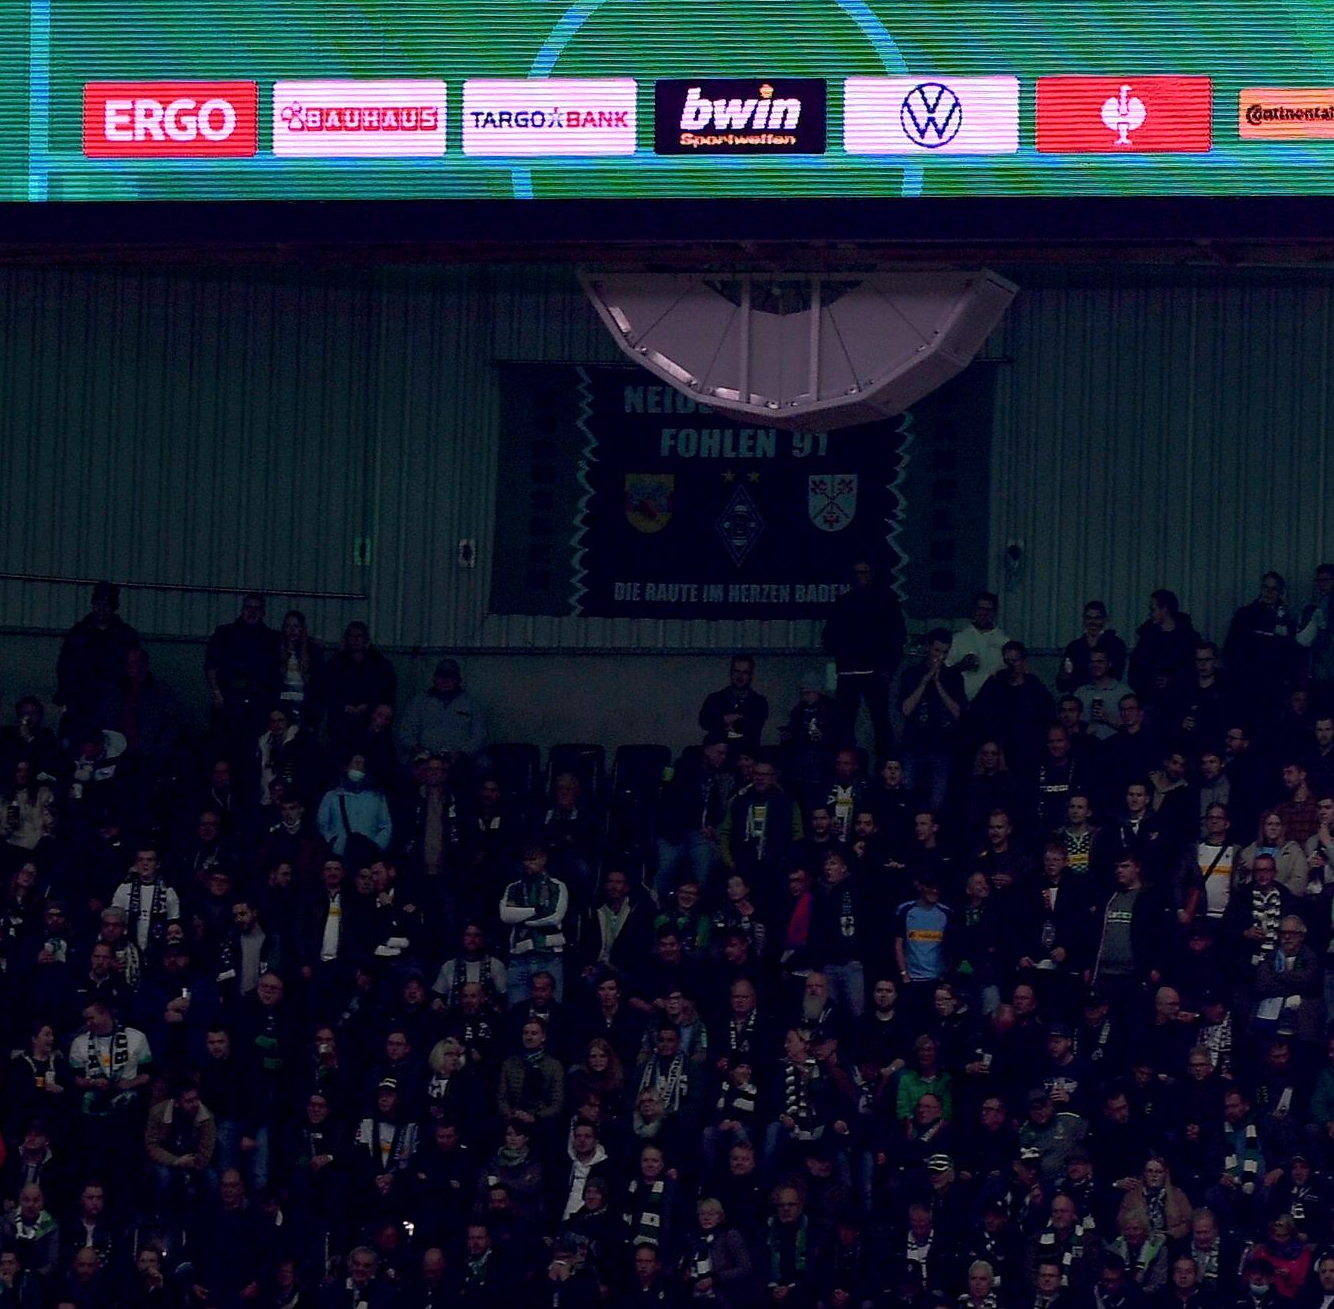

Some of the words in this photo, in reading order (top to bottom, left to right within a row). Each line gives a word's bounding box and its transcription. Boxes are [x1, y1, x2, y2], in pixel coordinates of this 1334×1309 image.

[104, 98, 237, 141] ERGO
[304, 107, 440, 130] BAUHAUS
[680, 83, 801, 130] bwin
[659, 428, 777, 458] FOHLEN
[613, 581, 641, 601] DIE
[644, 583, 699, 602] RAUTE
[702, 583, 724, 602] IM
[728, 583, 790, 603] HERZEN
